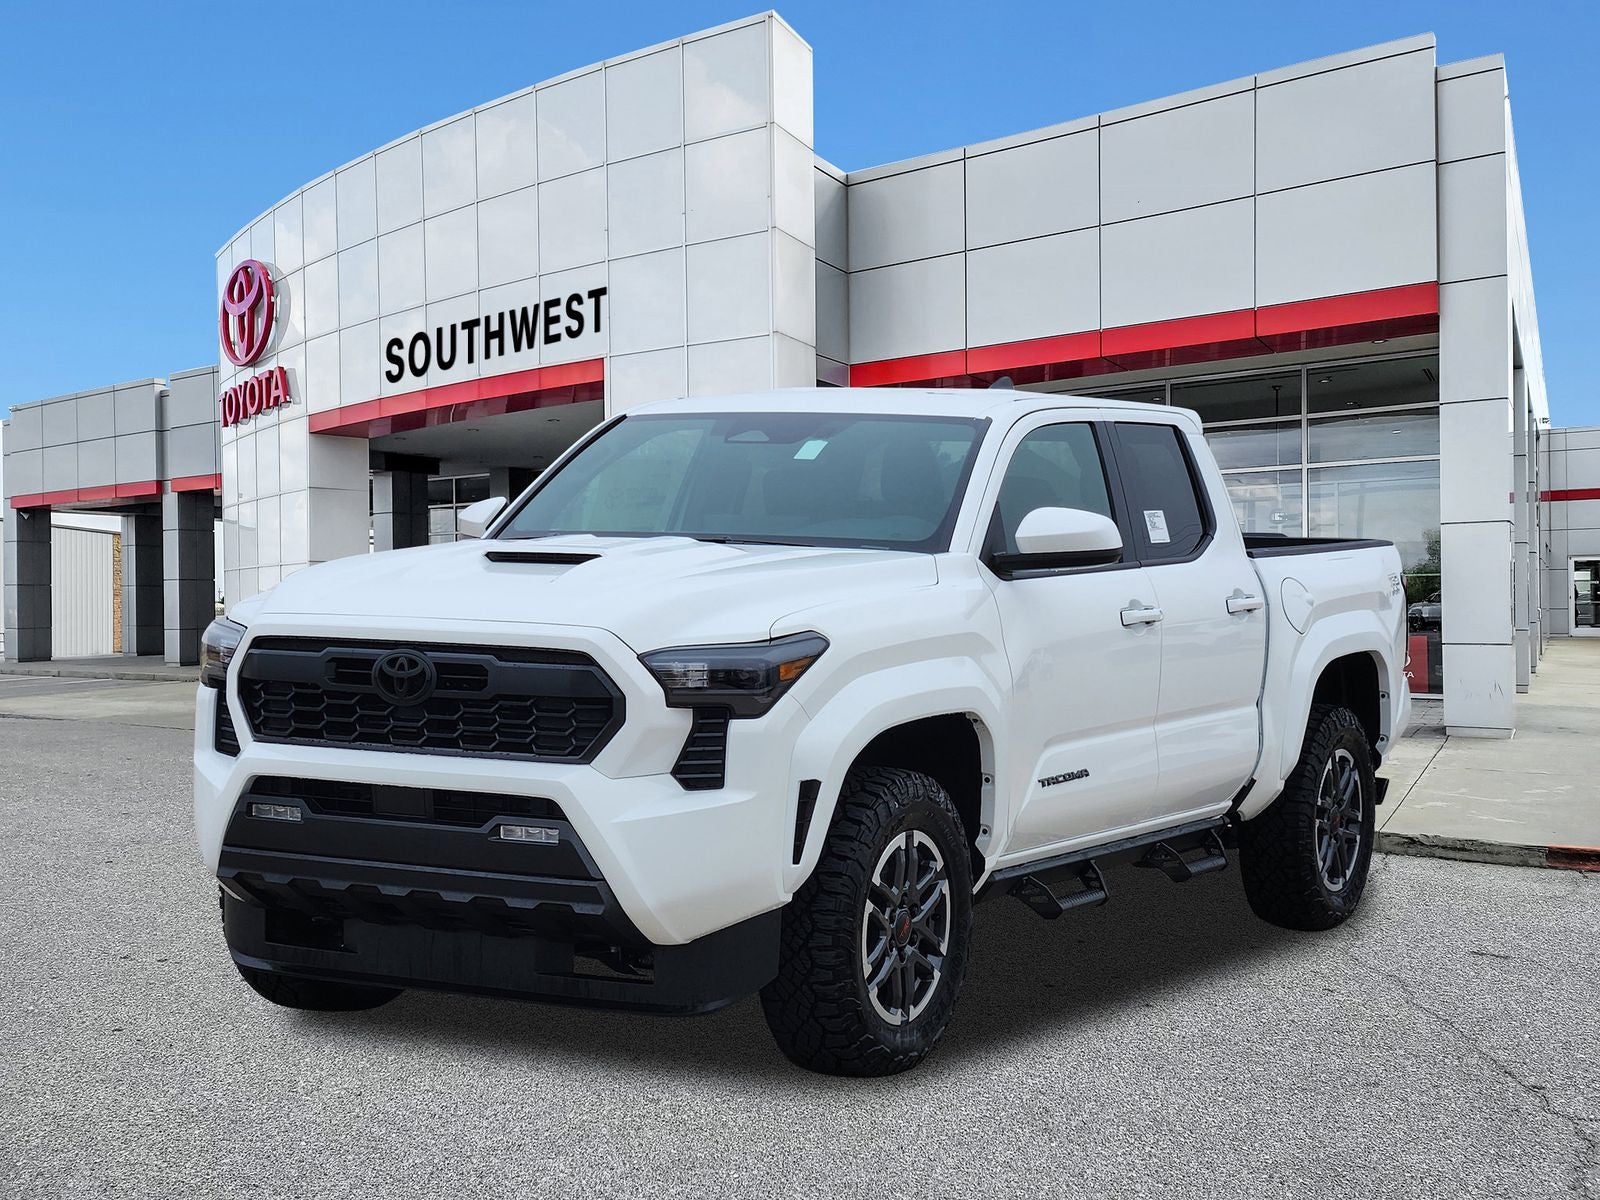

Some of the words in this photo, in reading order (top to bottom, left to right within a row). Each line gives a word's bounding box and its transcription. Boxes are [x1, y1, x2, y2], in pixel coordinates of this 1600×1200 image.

[385, 286, 608, 384] SOUTHWEST
[219, 366, 291, 427] TOYOTA
[1037, 768, 1090, 788] TACOMA
